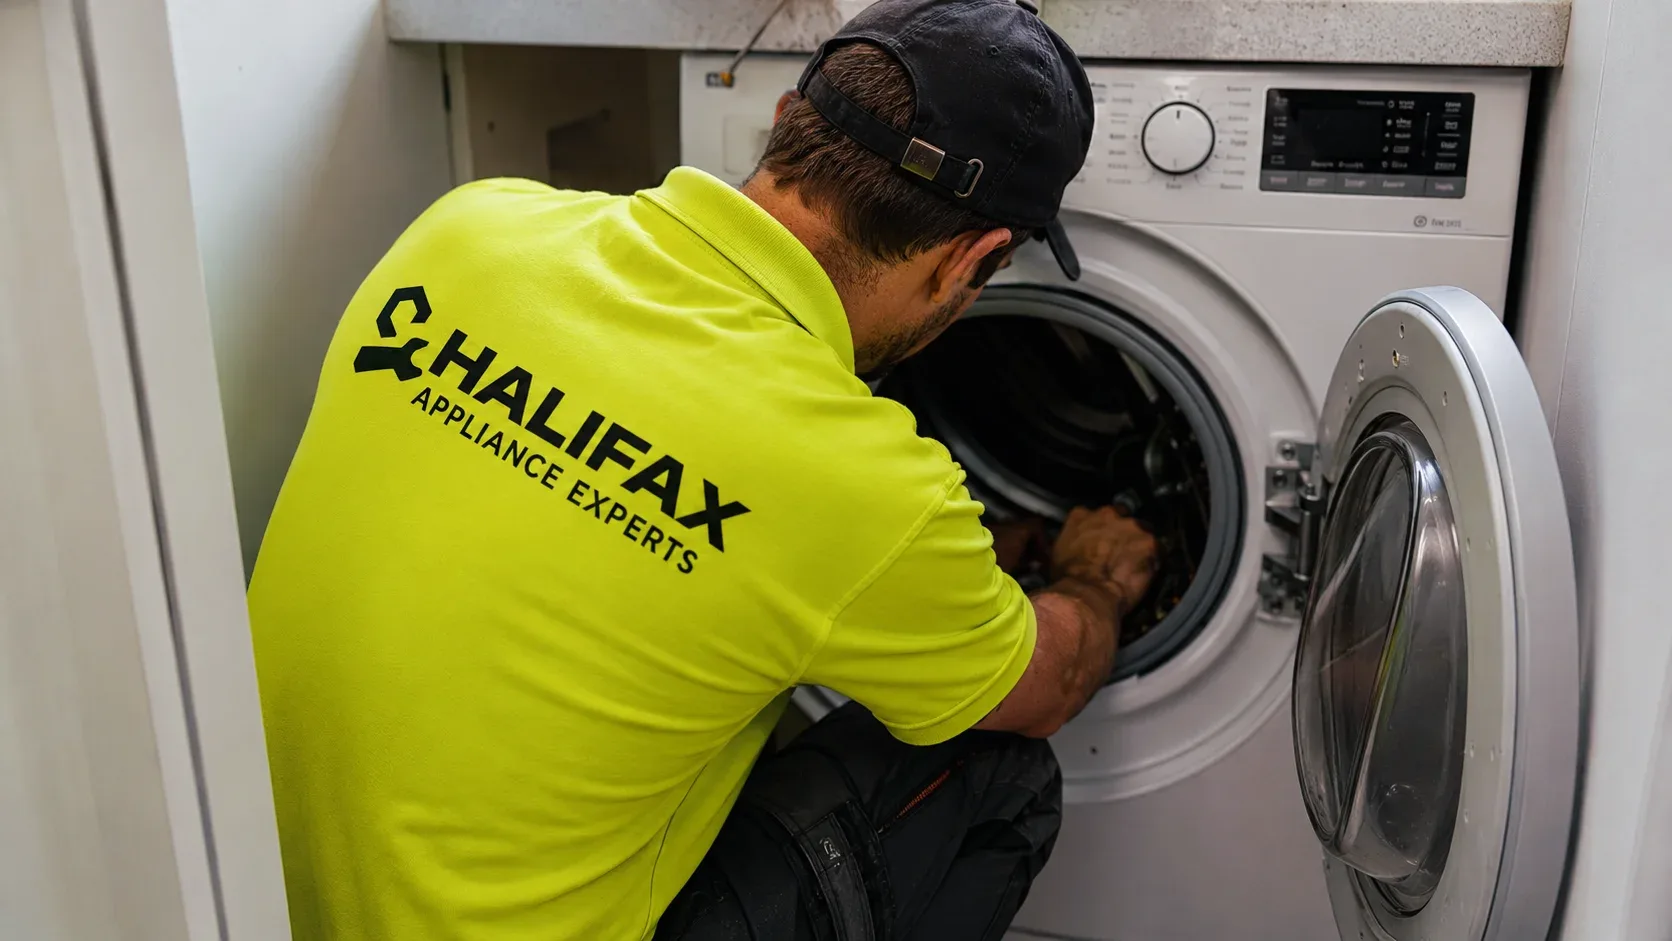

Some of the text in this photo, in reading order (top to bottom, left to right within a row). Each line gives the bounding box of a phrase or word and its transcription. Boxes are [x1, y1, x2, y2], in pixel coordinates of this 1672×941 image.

[410, 386, 698, 575] APPLIANCE EXPERTS
[428, 328, 752, 553] HALIFAX
